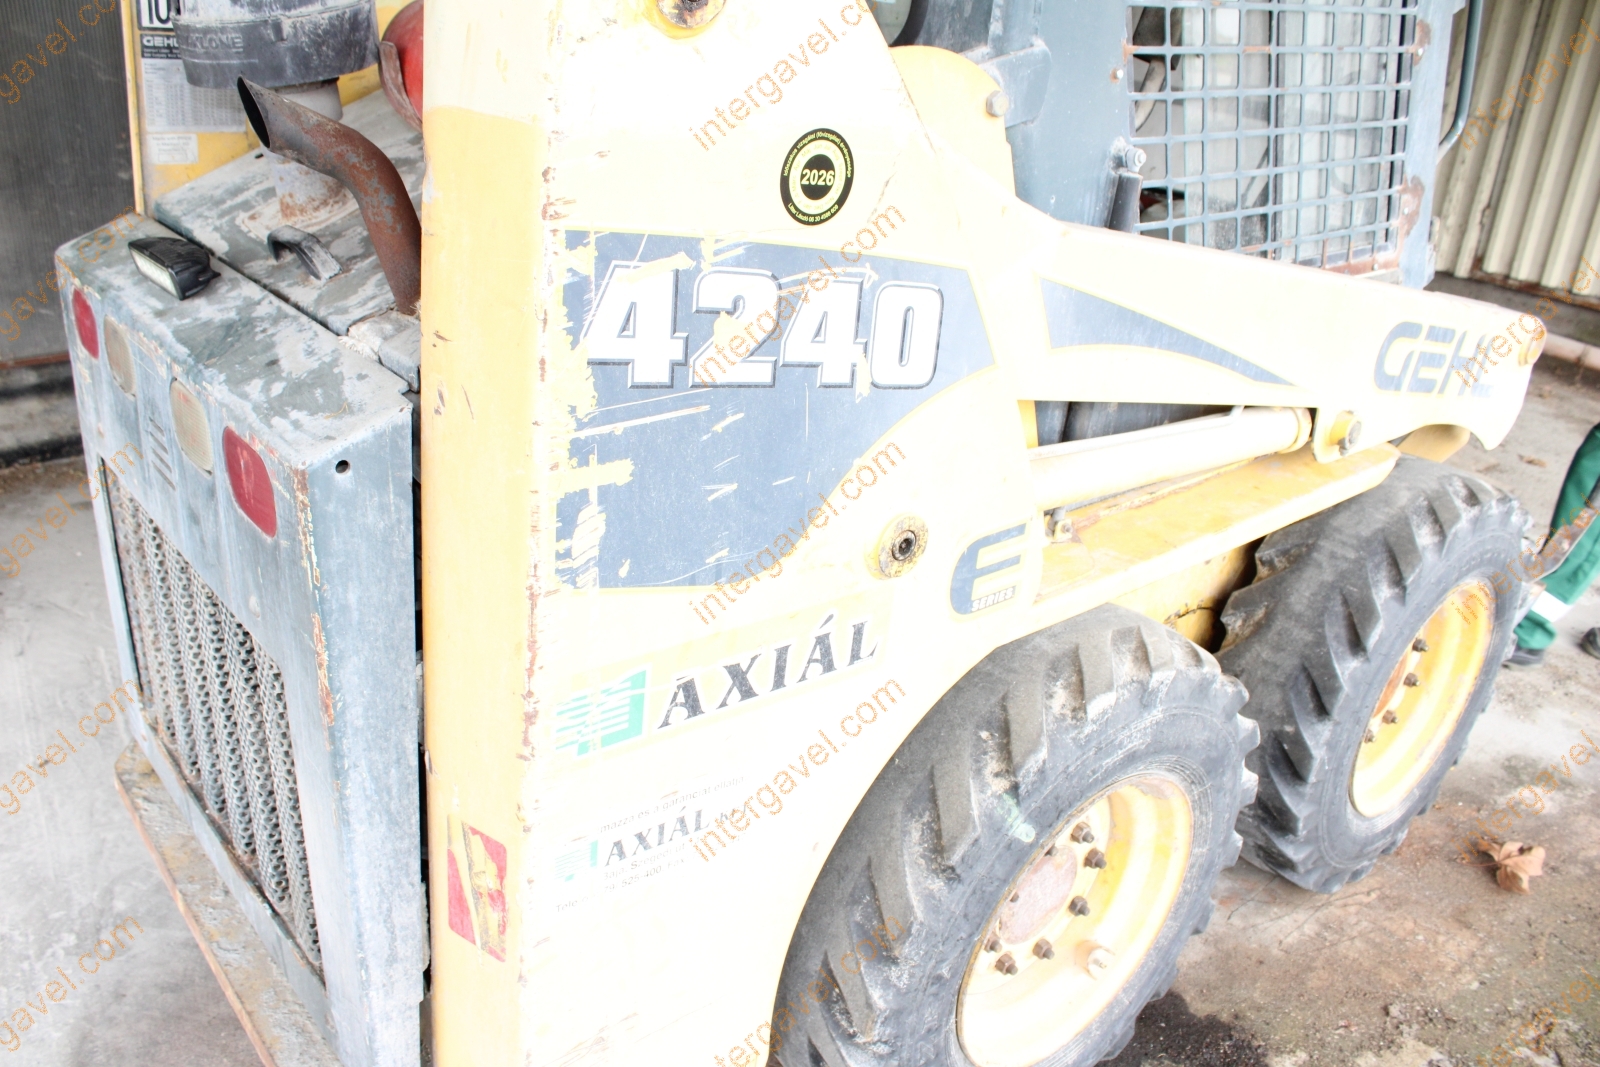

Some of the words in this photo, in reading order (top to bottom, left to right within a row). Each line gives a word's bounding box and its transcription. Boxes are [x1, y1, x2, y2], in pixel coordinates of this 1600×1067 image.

[801, 169, 835, 186] 2026
[579, 260, 945, 389] 4240
[1373, 320, 1495, 398] GEHL
[950, 522, 1026, 614] E
[971, 586, 1015, 612] SERIES
[657, 614, 879, 729] AXIÁL
[604, 806, 711, 867] AXIÁL
